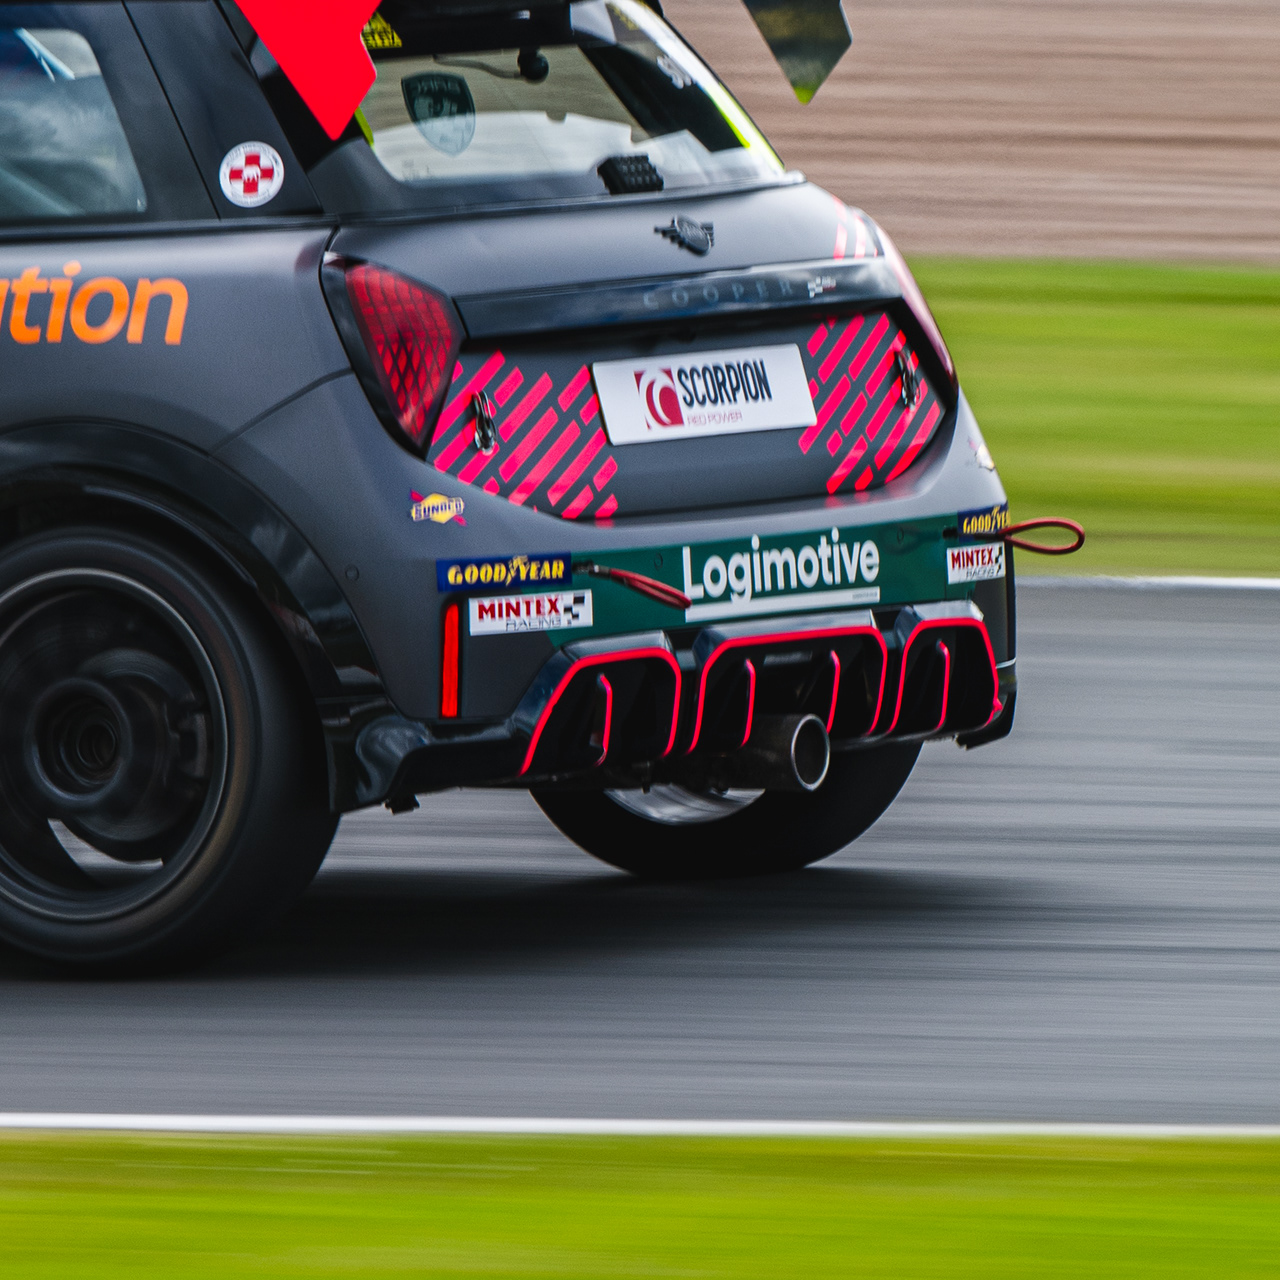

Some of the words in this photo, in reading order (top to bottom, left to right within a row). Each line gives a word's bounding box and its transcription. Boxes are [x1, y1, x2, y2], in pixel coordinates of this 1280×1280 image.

[643, 279, 793, 310] COOPER
[677, 358, 772, 408] SCORPION
[686, 412, 707, 426] RED
[708, 410, 743, 424] POWER
[413, 498, 464, 521] SUNOCO
[447, 556, 565, 586] GOODYEAR
[682, 526, 880, 603] Logimotive
[951, 547, 994, 569] MINTEX
[478, 595, 561, 621] MINTEX
[505, 617, 562, 632] RACING
